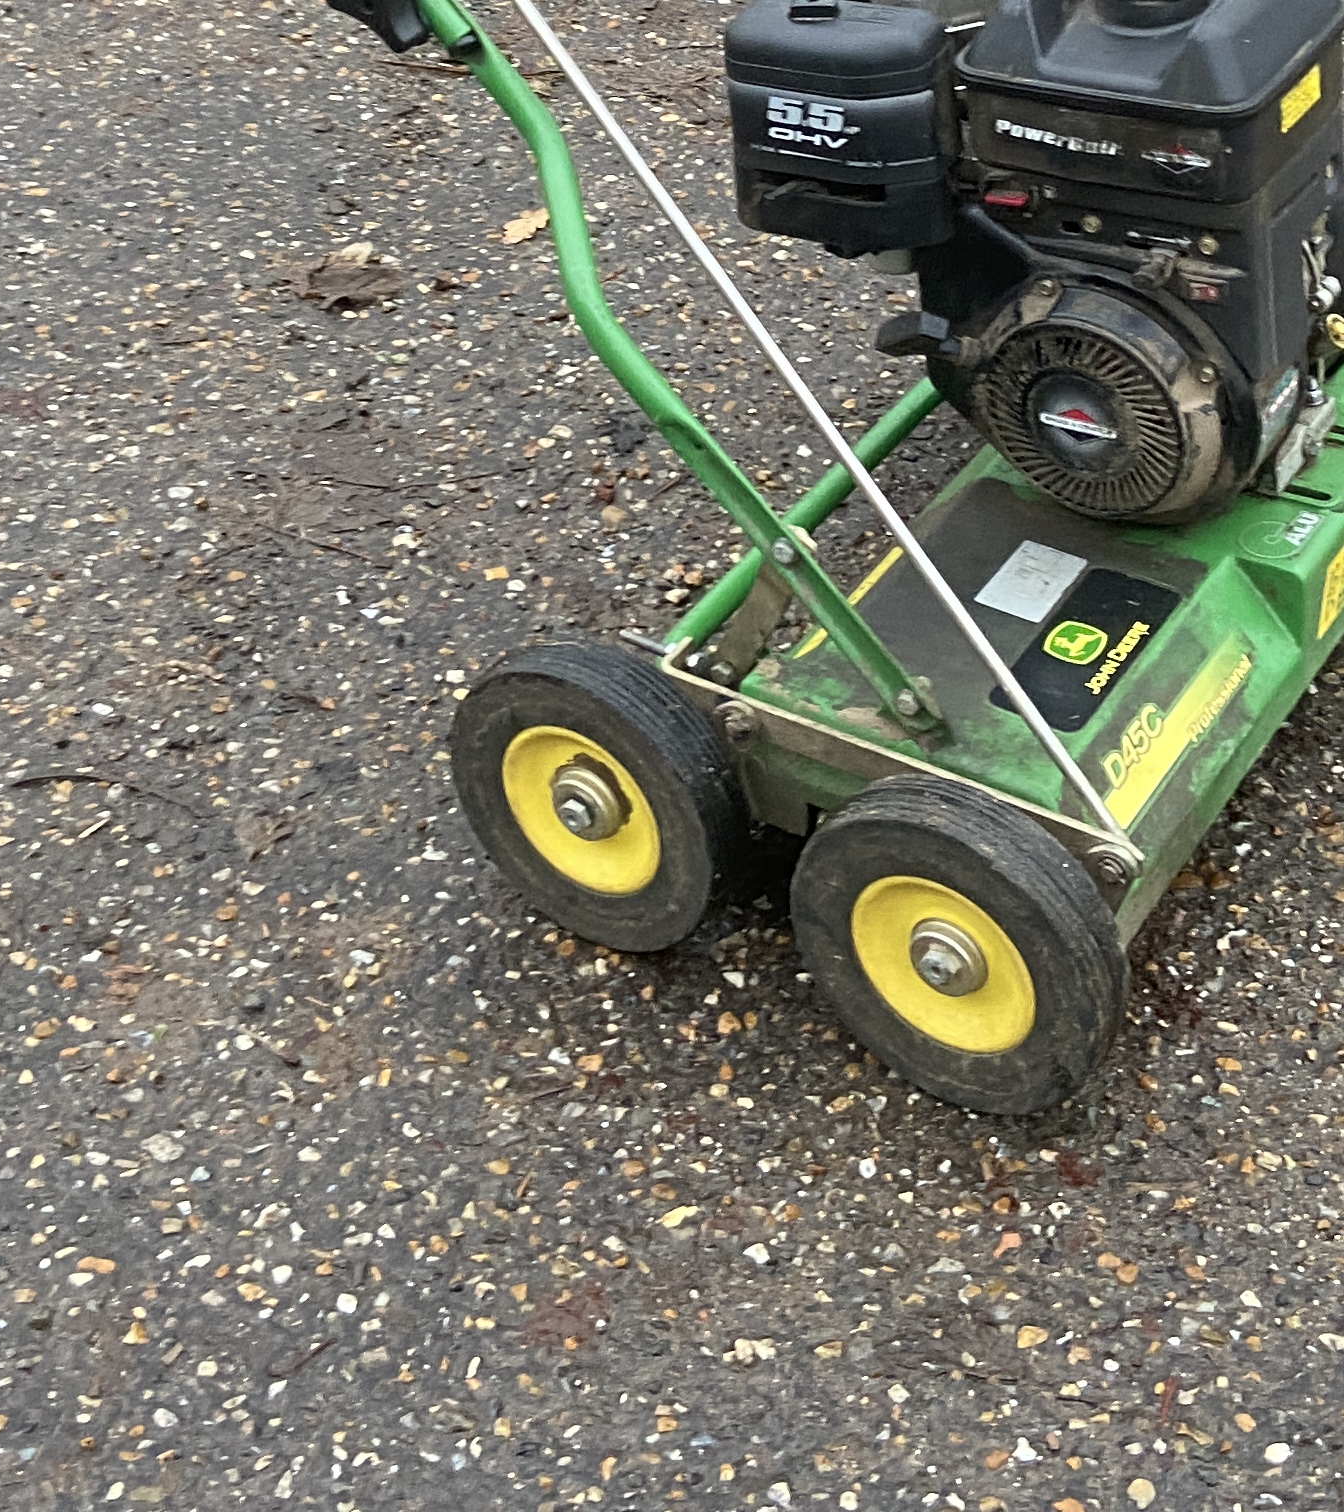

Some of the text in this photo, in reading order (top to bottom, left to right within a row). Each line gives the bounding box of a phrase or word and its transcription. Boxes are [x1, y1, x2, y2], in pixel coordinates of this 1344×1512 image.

[767, 126, 849, 149] OHV
[1285, 510, 1322, 547] ALU
[1083, 658, 1121, 696] JOHN
[1100, 703, 1164, 790] D45C
